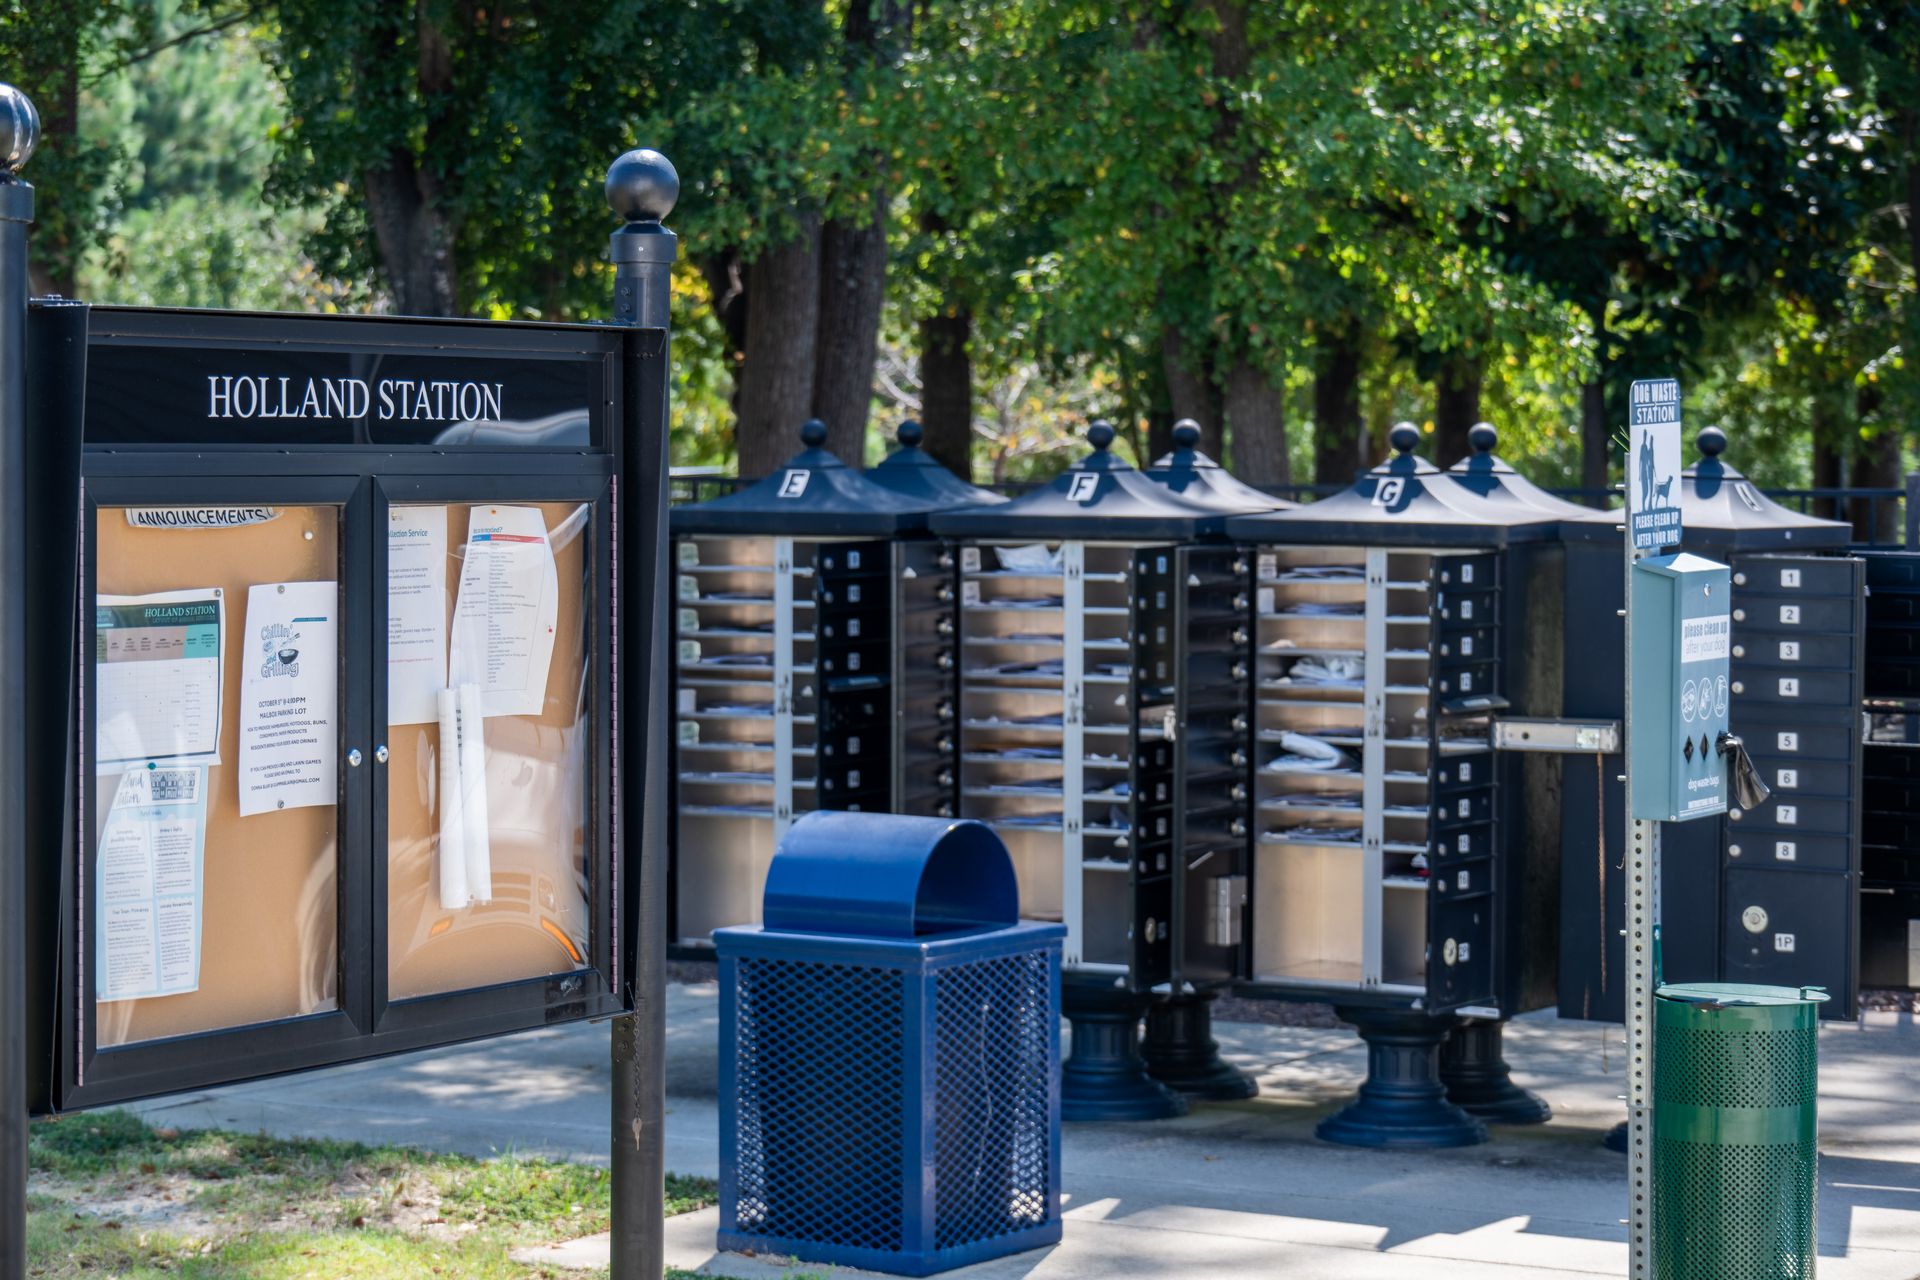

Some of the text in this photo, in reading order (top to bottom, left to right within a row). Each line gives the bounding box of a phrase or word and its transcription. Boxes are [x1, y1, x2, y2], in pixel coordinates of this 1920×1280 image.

[207, 376, 503, 421] HOLLAND STATION
[1634, 382, 1677, 403] DOG WASTE
[1636, 406, 1675, 424] STATION
[137, 508, 268, 526] ANNOUNCEMENTS
[1635, 511, 1679, 529] PLEASE CLEAN UP
[1636, 529, 1678, 546] AFTER YOUR DOG
[144, 605, 216, 618] HOLLAND STATION
[1684, 620, 1728, 639] please clean up
[258, 699, 277, 708] OCTOBER
[259, 707, 307, 719] MAILBOX PARKING LOT
[1687, 778, 1697, 792] dog
[1776, 937, 1793, 948] 1P
